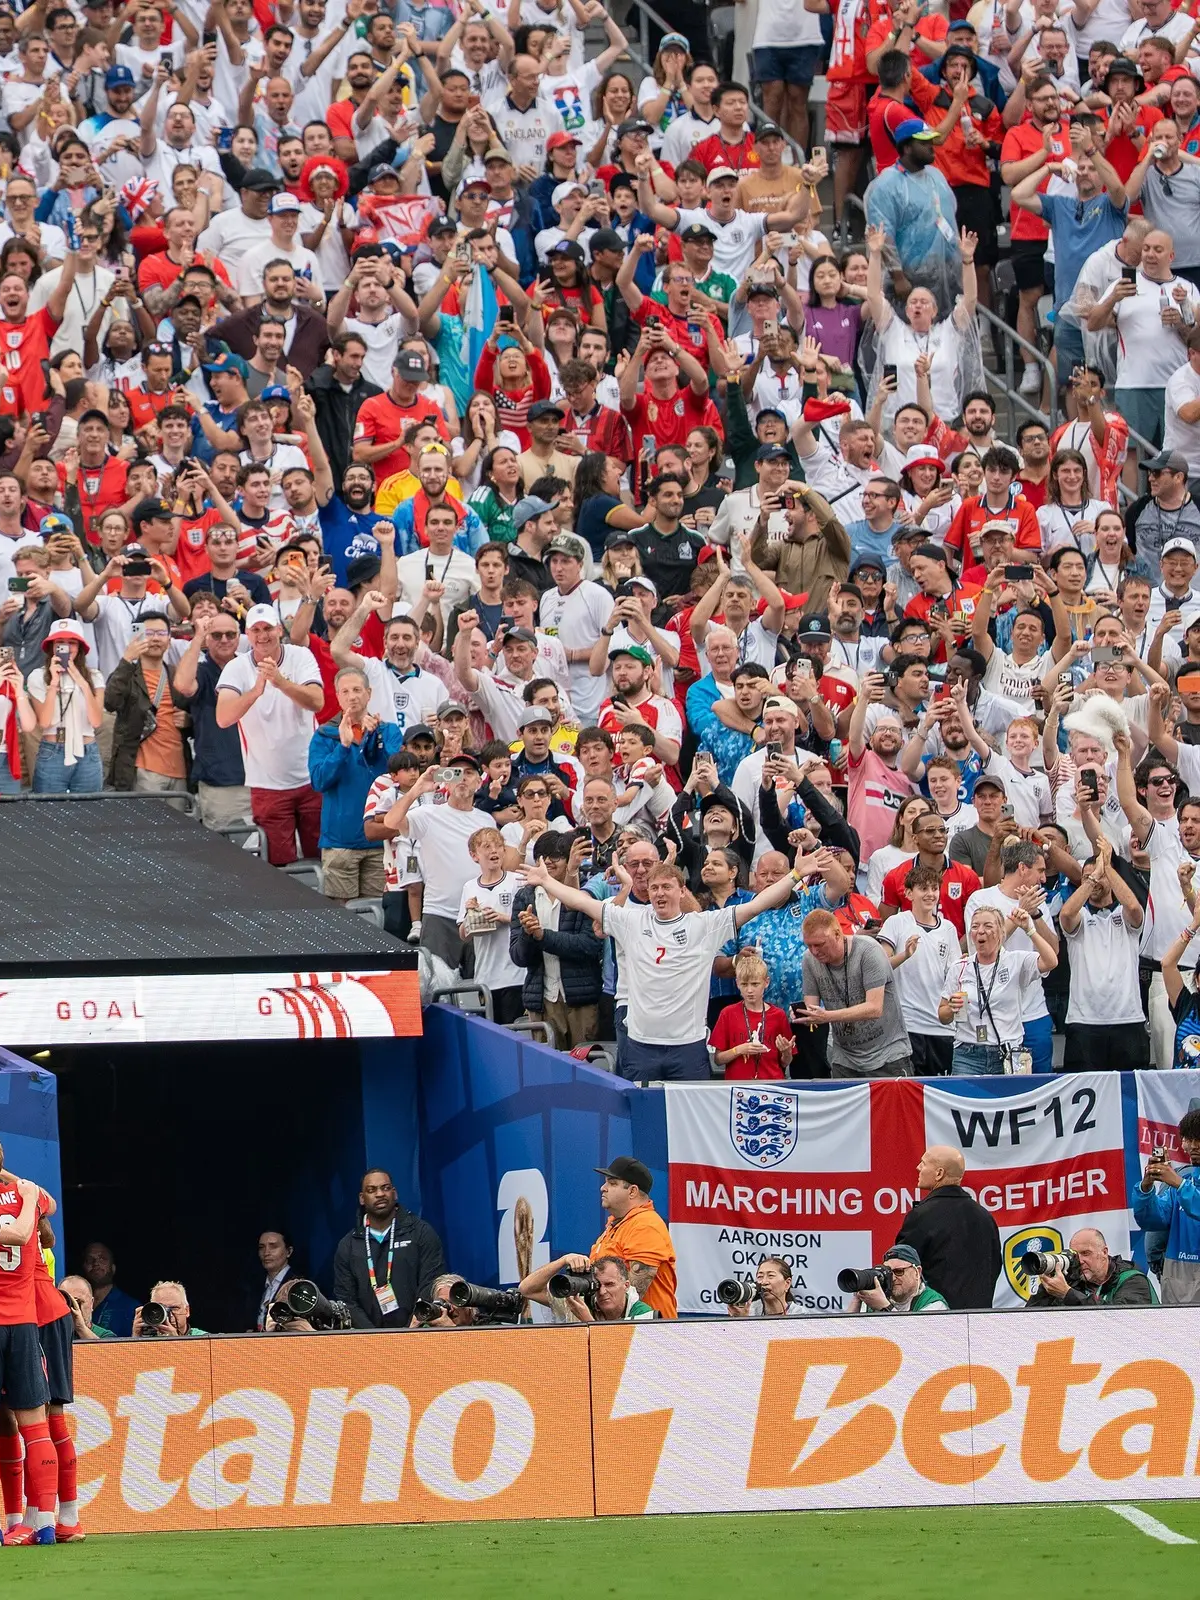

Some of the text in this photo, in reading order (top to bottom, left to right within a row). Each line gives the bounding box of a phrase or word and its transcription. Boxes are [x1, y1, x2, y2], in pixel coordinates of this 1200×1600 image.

[504, 127, 546, 141] ENGLAND
[656, 948, 665, 964] 7
[56, 1001, 144, 1020] GOAL
[950, 1087, 1096, 1148] WF12
[1140, 1126, 1179, 1152] DUL
[685, 1168, 1107, 1215] MARCHING ON GETHER
[718, 1228, 821, 1248] AARONSON
[732, 1250, 808, 1268] OKAOR
[733, 1271, 807, 1288] TAA
[746, 1336, 1200, 1489] Beta
